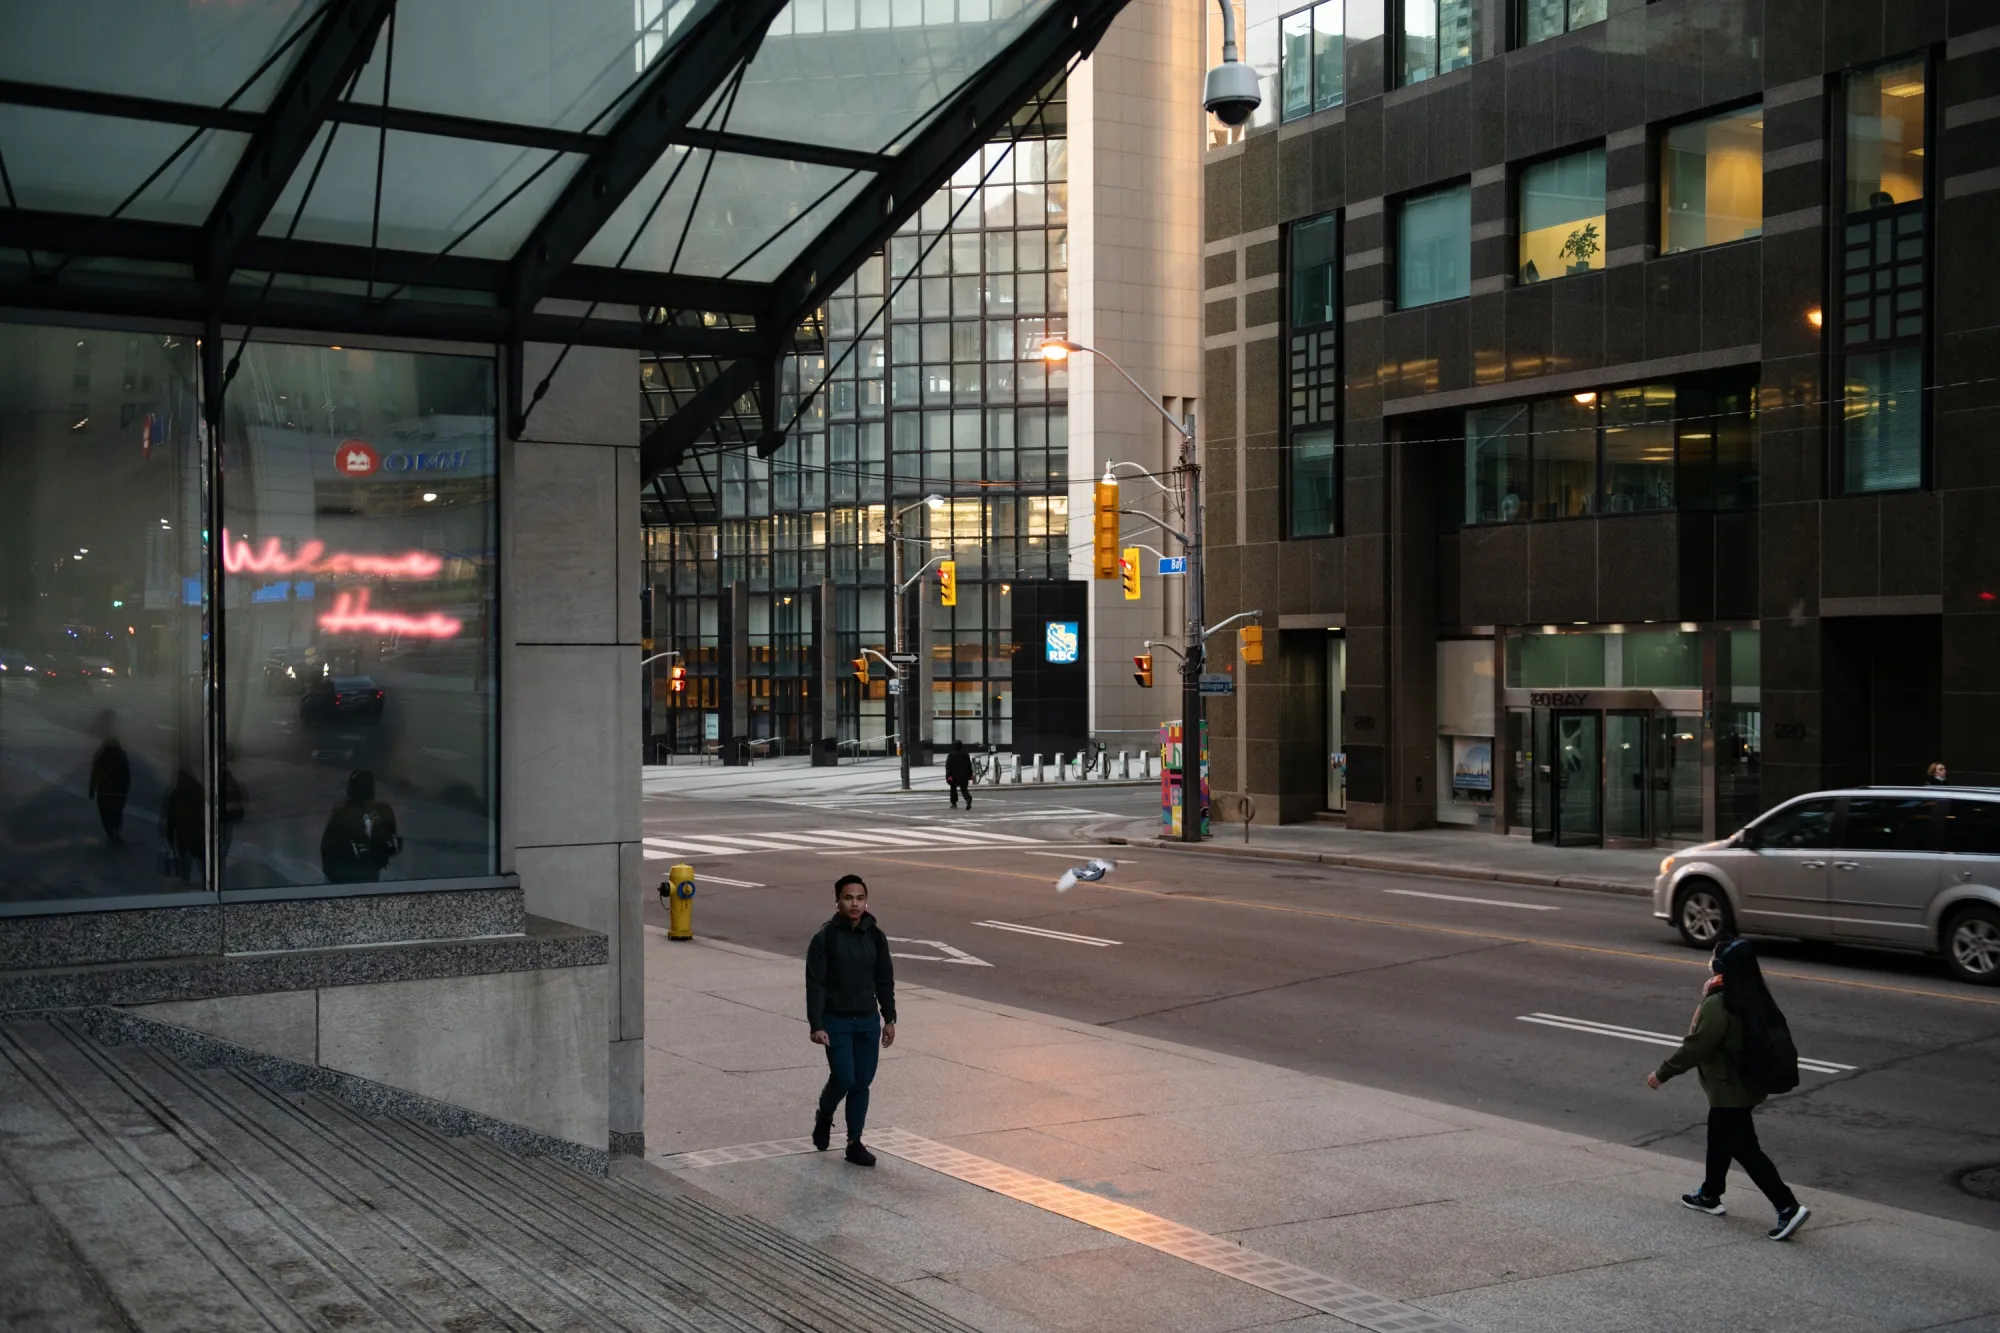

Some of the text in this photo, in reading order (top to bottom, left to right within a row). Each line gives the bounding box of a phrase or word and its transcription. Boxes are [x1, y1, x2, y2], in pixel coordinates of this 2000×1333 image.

[222, 527, 443, 577] Welcome
[1171, 559, 1183, 571] Bay
[317, 587, 462, 638] Home
[1049, 650, 1076, 661] RBC
[1200, 683, 1224, 691] Wellington
[1552, 692, 1588, 707] BAY
